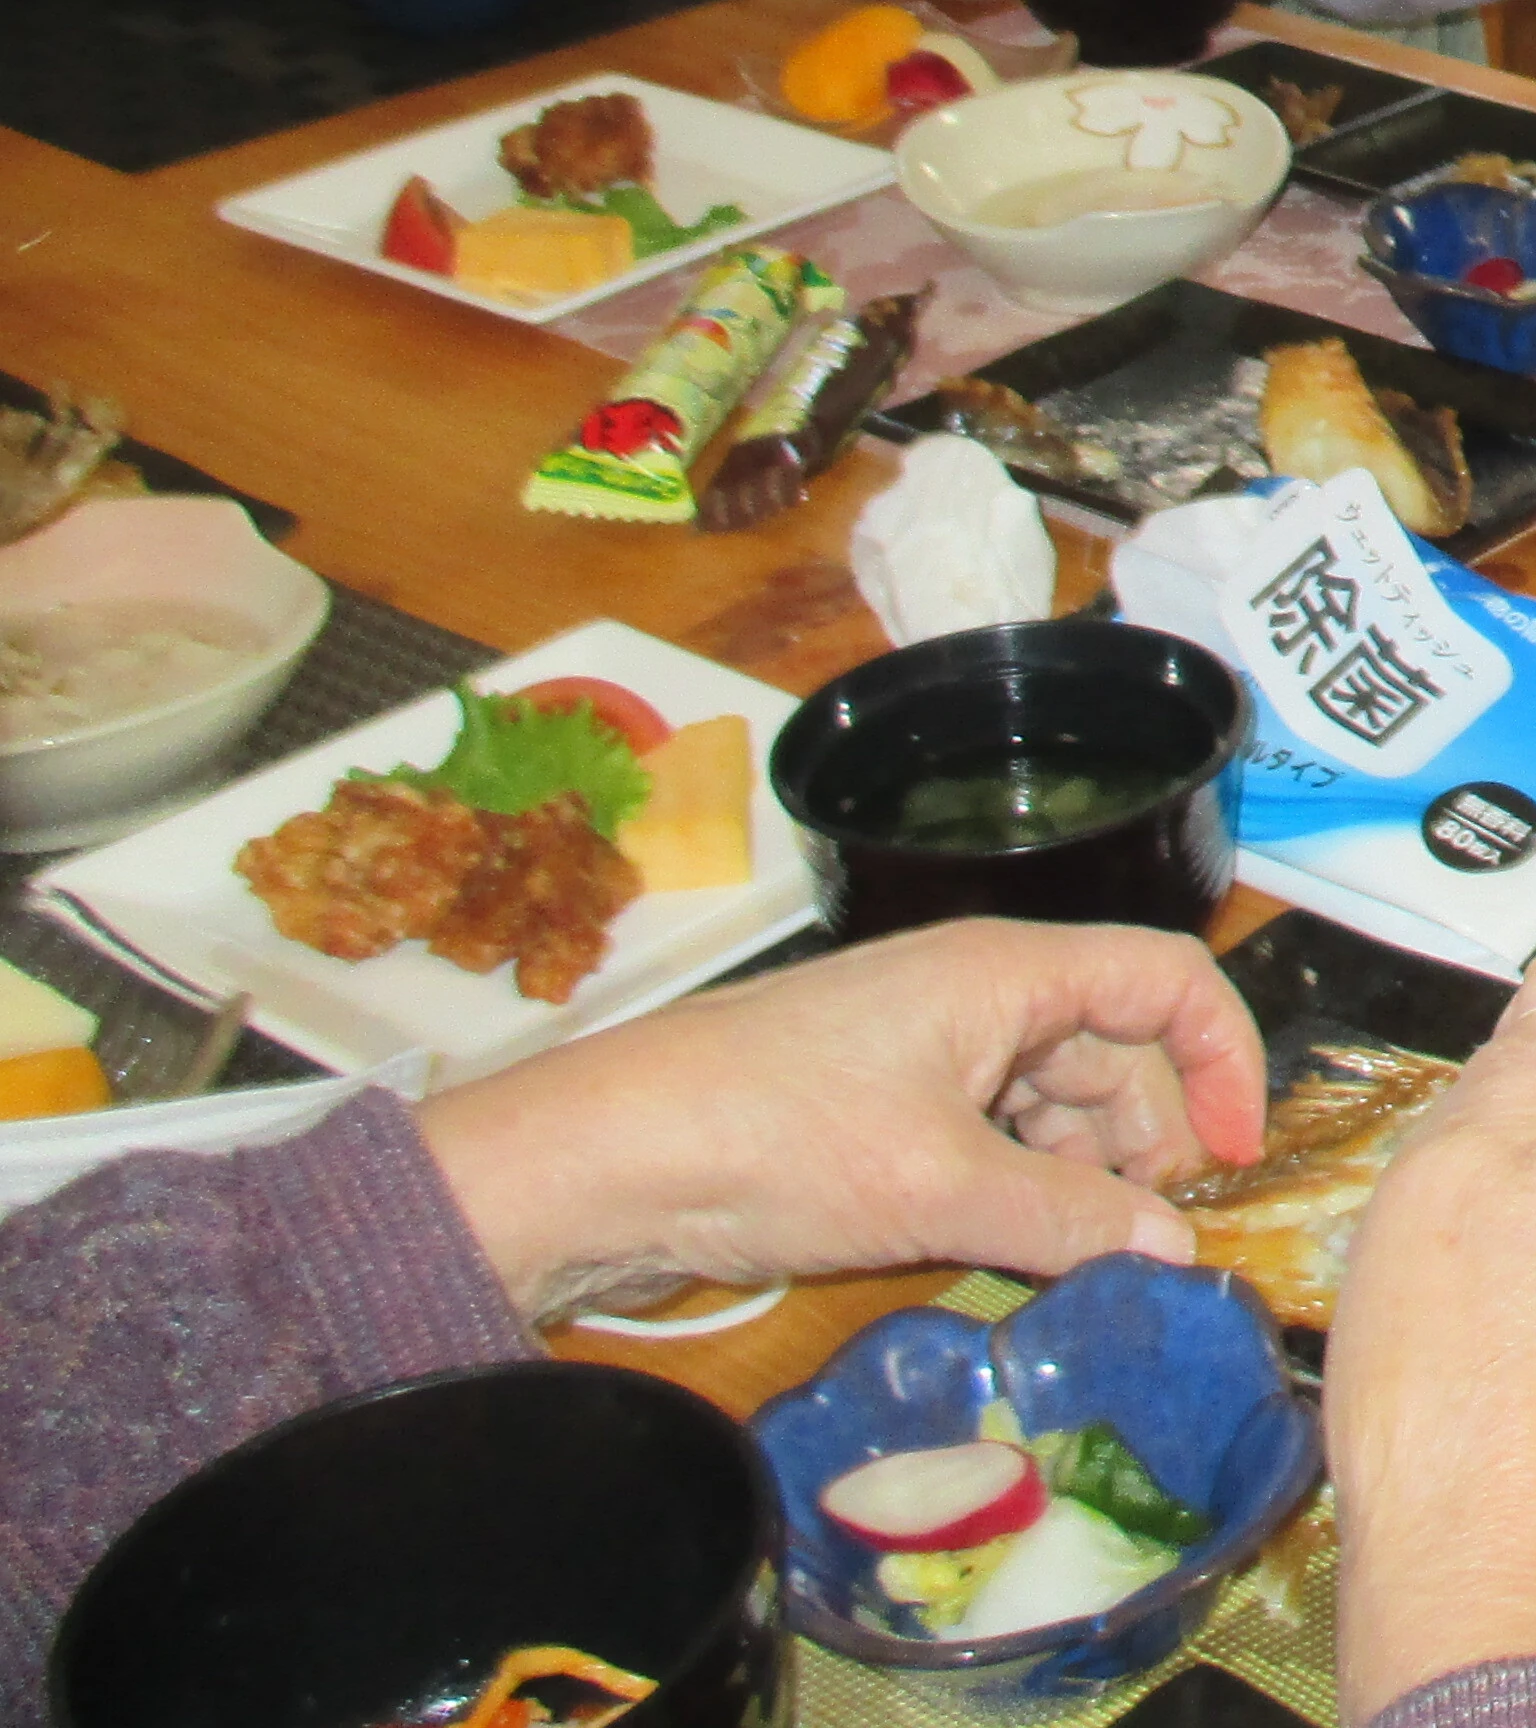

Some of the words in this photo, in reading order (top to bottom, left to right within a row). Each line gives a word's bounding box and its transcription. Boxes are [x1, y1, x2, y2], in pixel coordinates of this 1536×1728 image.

[1250, 534, 1447, 748] 除菌
[1335, 500, 1475, 680] ウェットティッシュ
